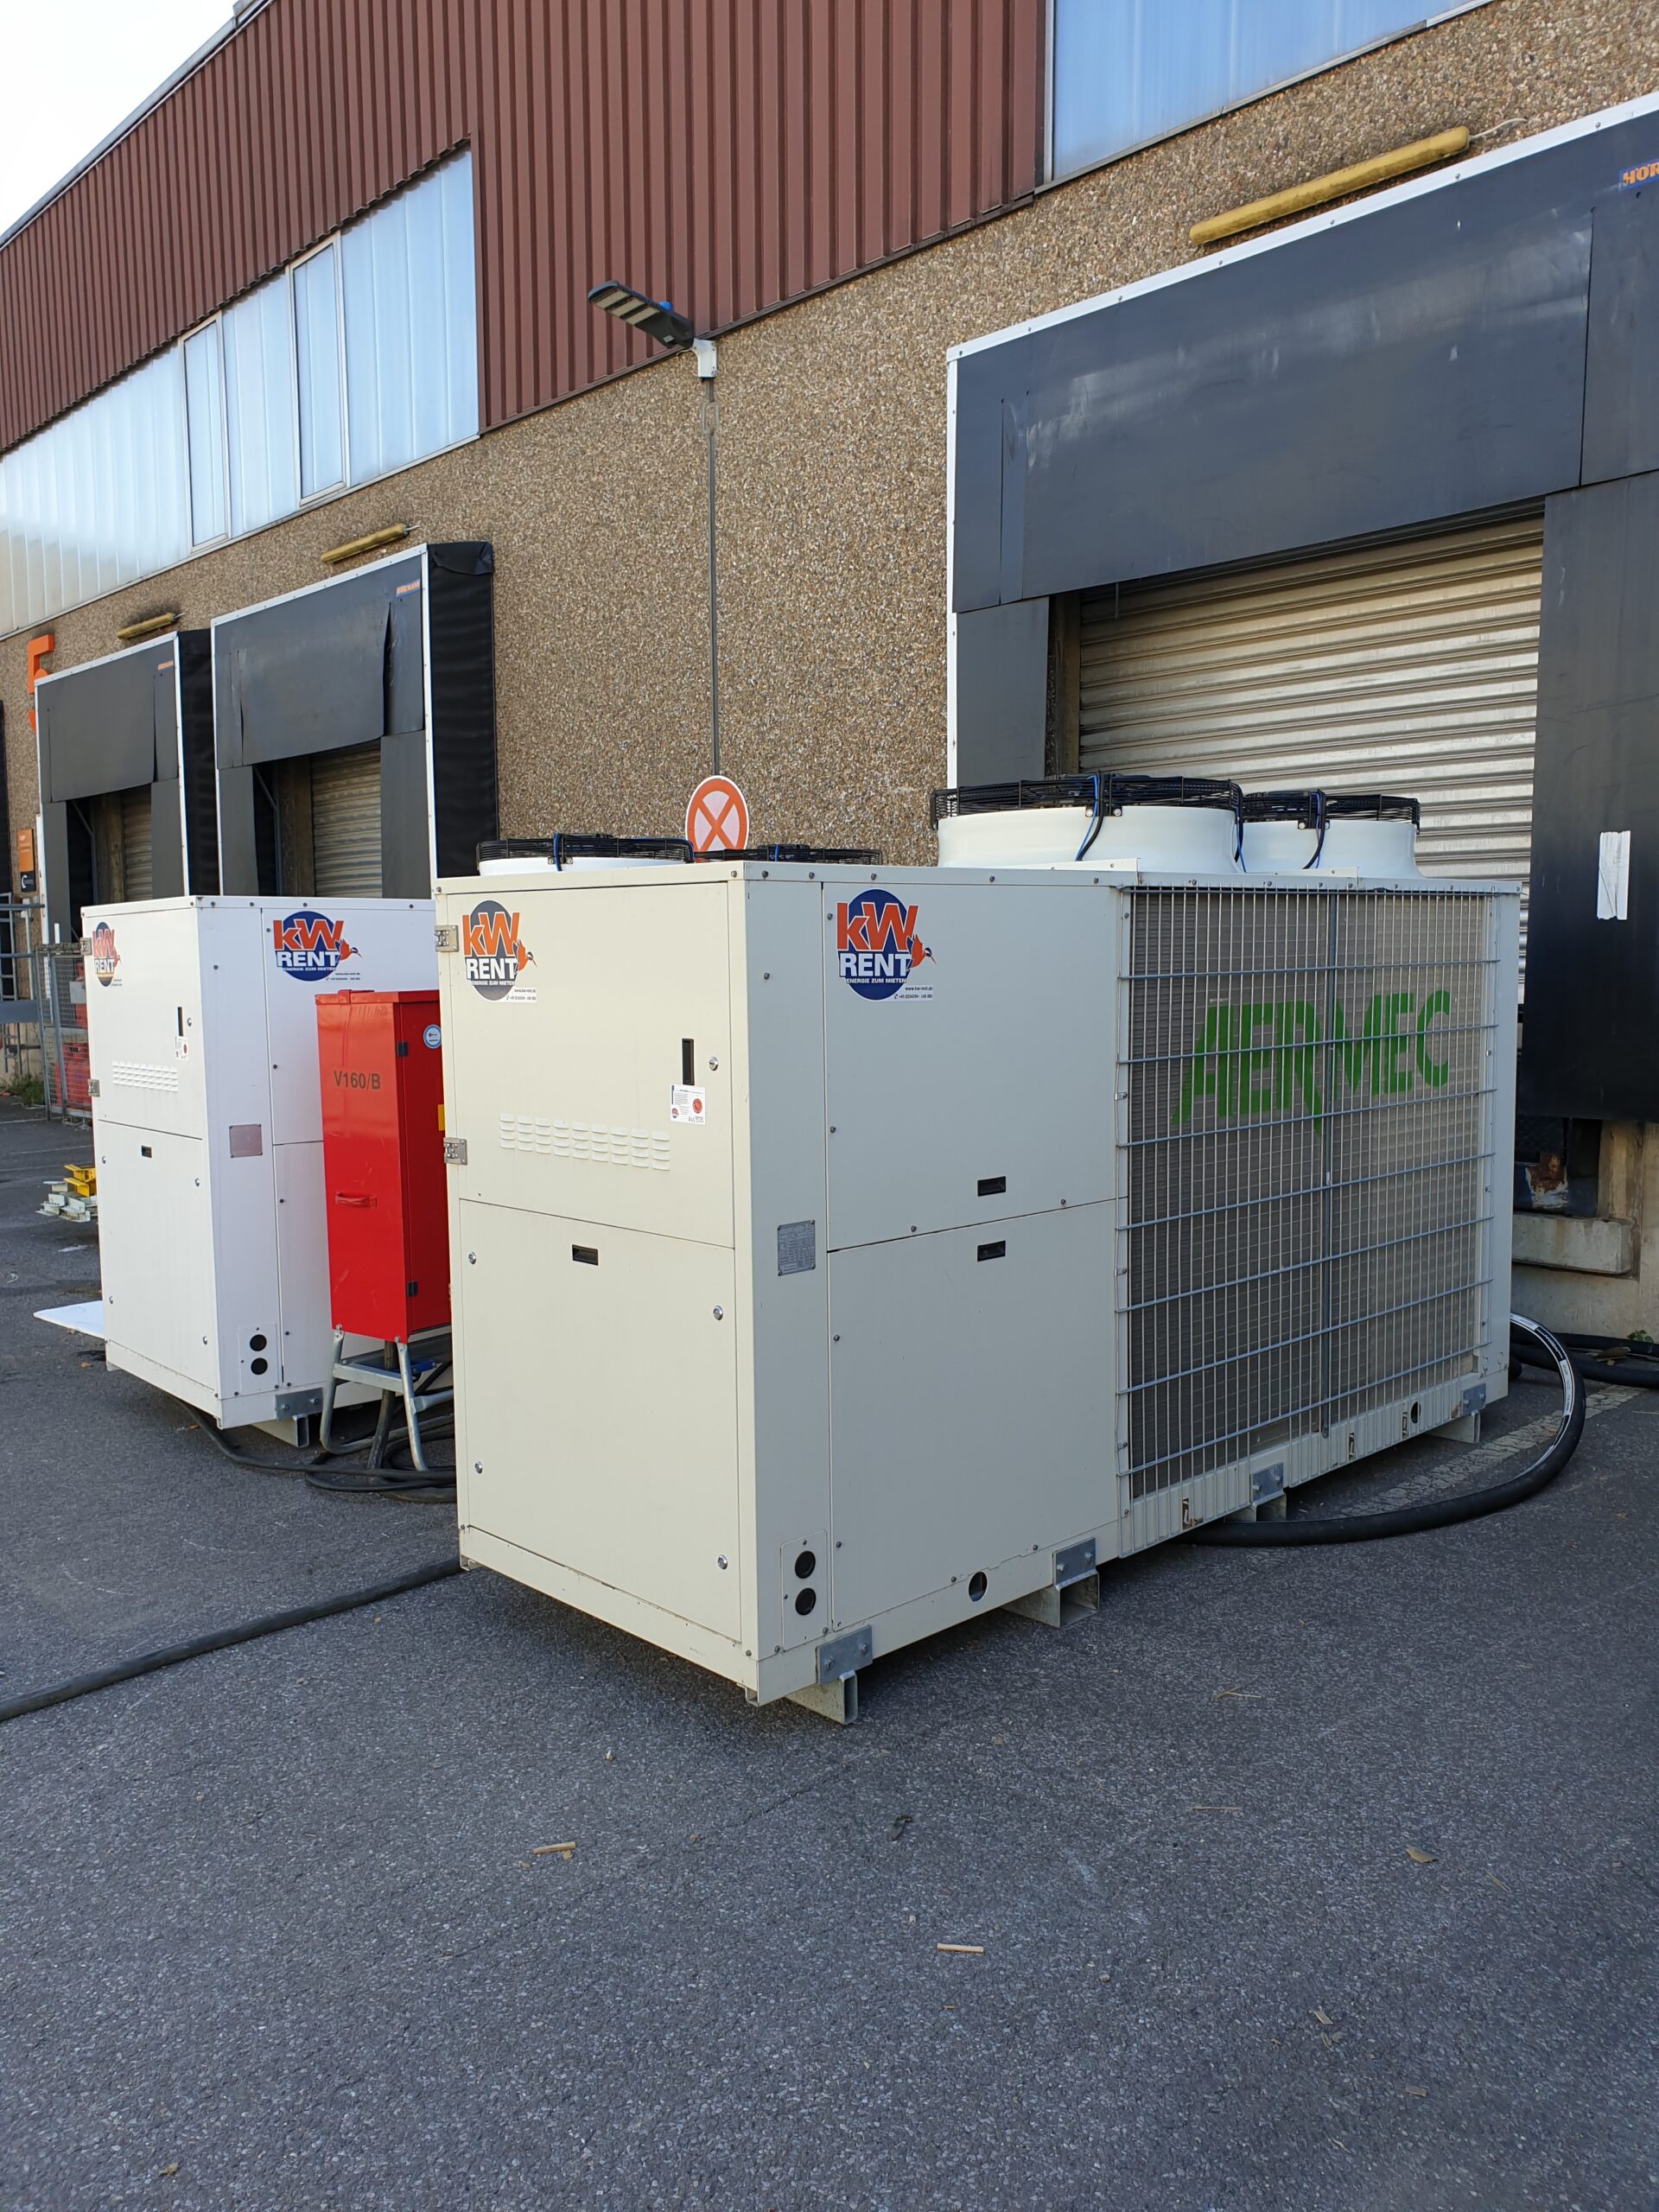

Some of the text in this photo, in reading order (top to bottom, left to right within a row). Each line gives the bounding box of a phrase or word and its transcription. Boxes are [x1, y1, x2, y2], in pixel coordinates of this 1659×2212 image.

[94, 958, 115, 973] RENT
[276, 950, 340, 967] RENT
[466, 957, 518, 980] RENT
[839, 952, 912, 977] RENT
[1172, 989, 1450, 1139] AERMEC
[333, 1070, 381, 1090] V160/B
